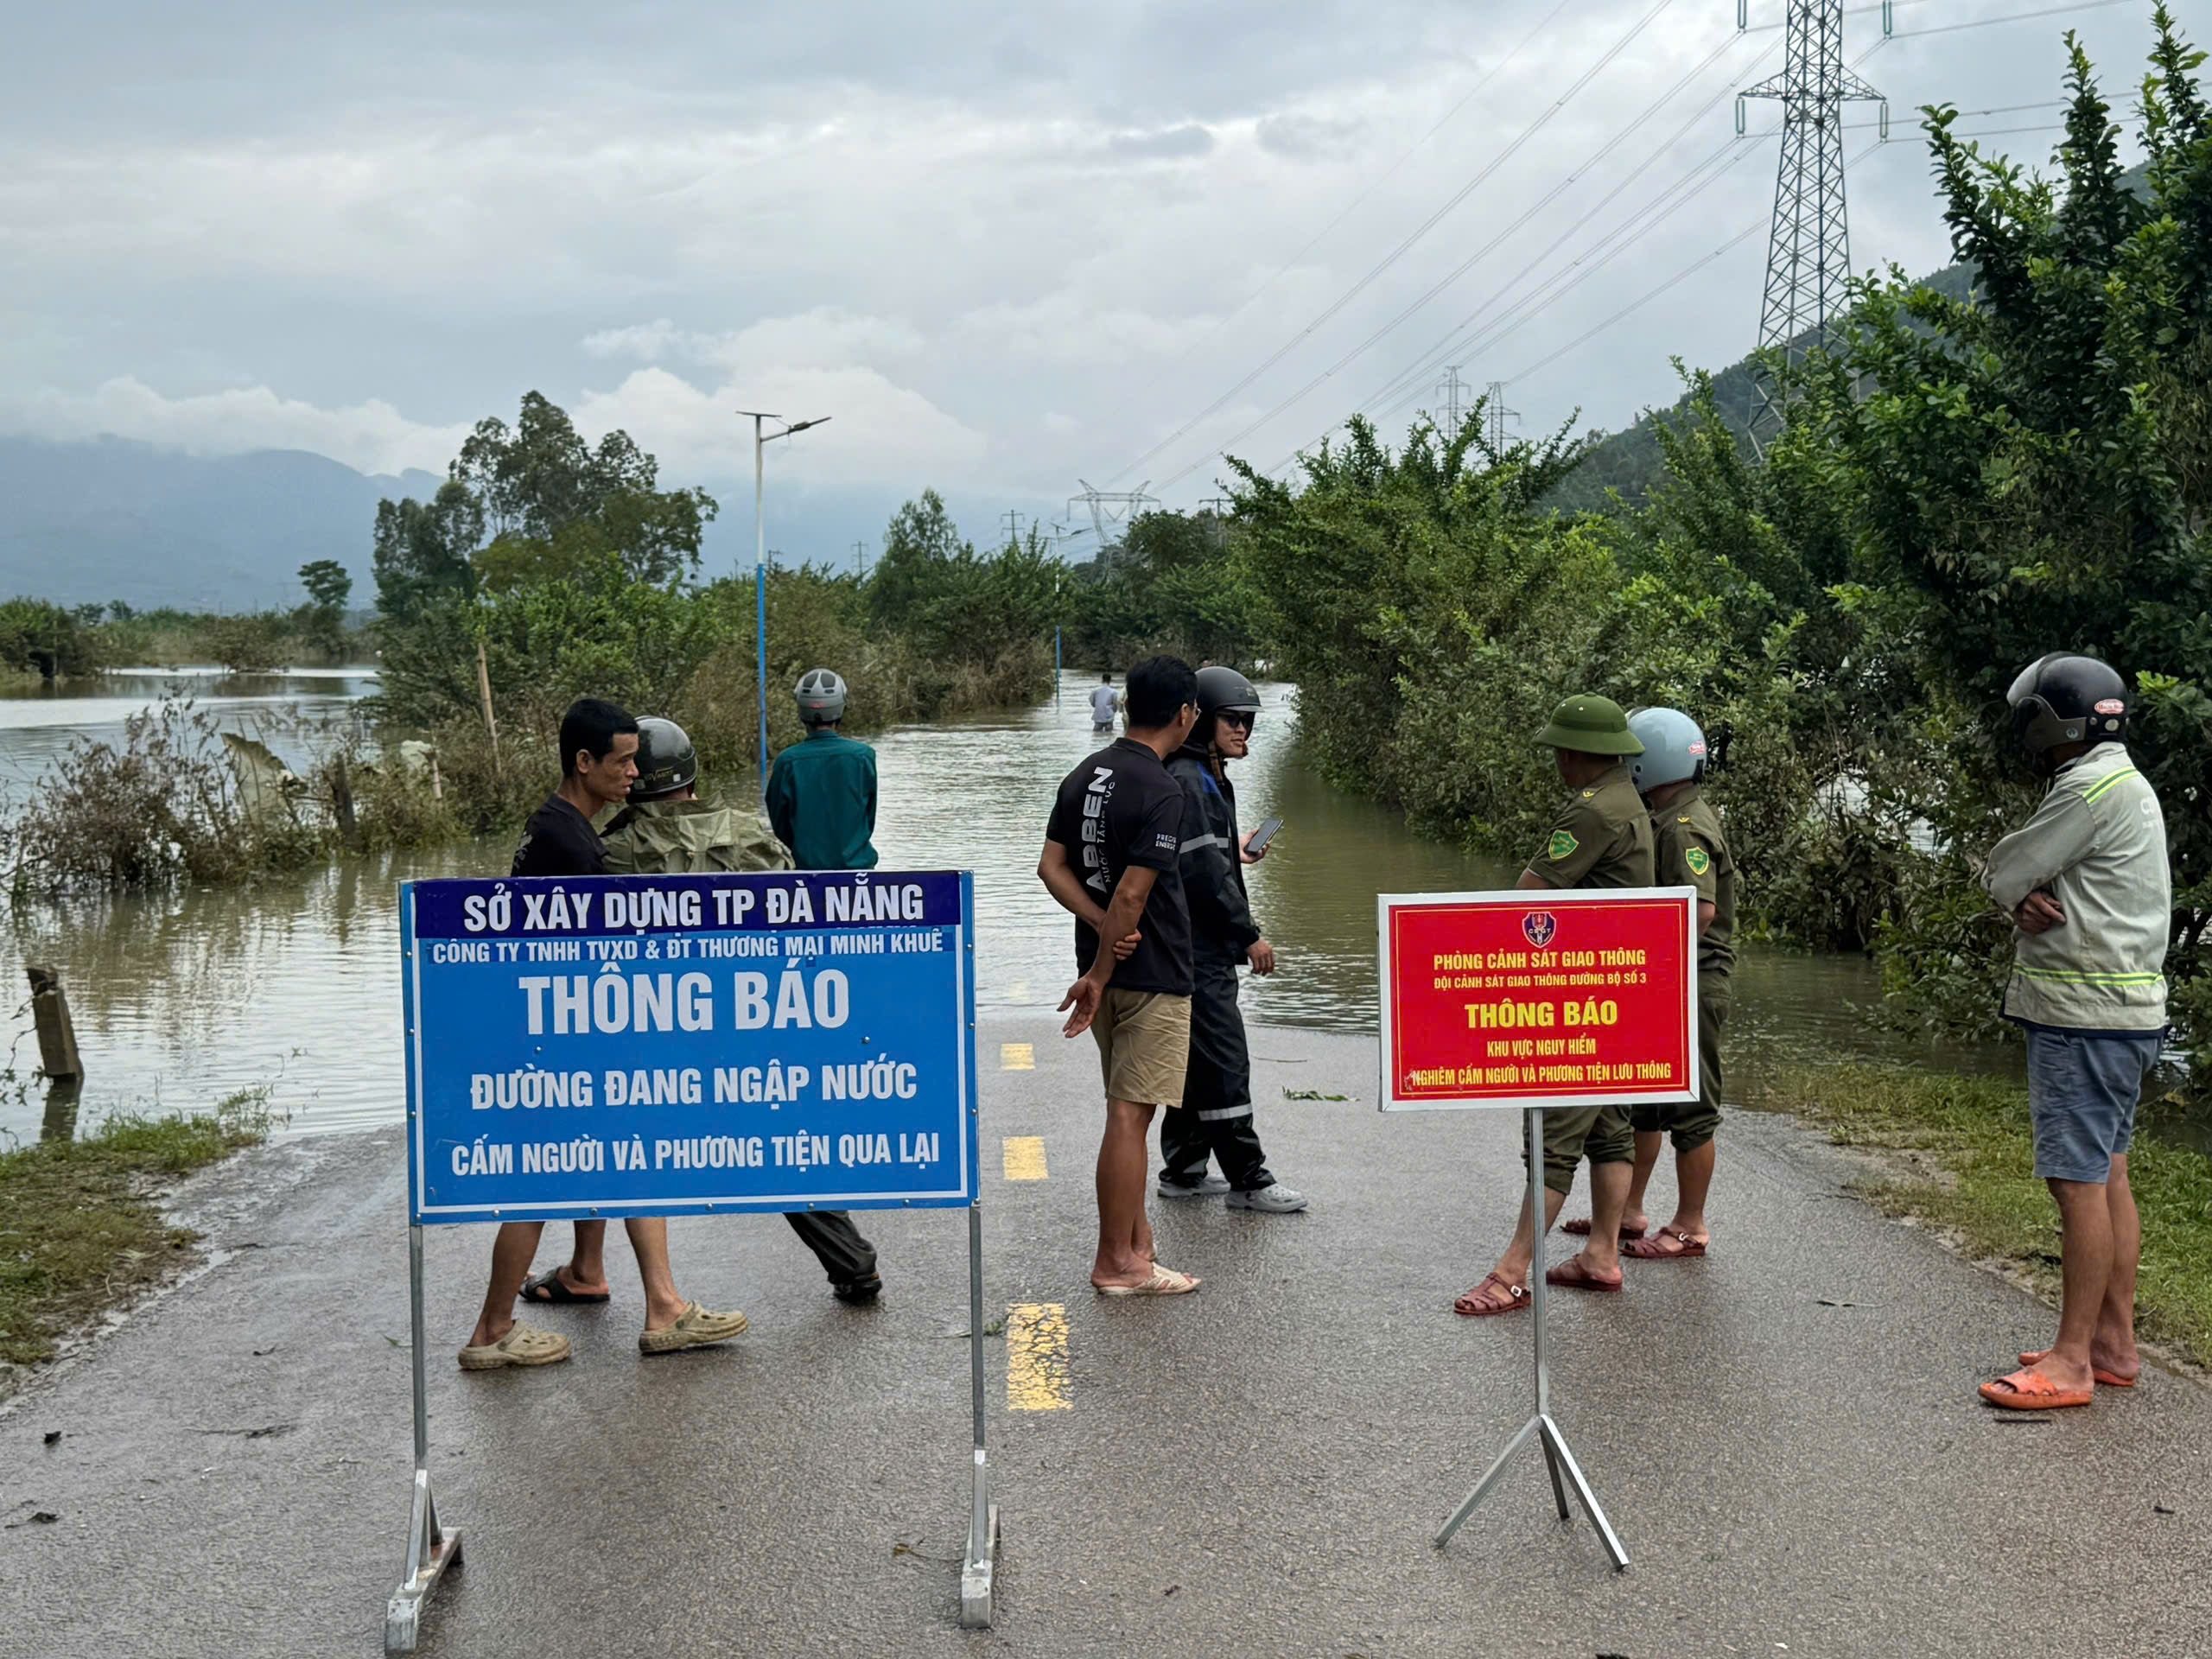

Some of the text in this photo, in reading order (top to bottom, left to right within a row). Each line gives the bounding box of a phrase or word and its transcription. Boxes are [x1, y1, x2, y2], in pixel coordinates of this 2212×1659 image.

[1081, 766, 1114, 894] ABBEN
[465, 872, 924, 935] SỞ XÂY DỰNG TP ĐÀ NẴNG
[433, 928, 944, 963] CÔNG TY TNHH TVXD & ĐT THƯƠNG MẠI MINH KHUÊ
[1433, 947, 1645, 970] PHÒNG CẢNH SÁT GIAO THÔNG
[519, 957, 849, 1035] THÔNG BÁO
[1433, 969, 1646, 991] ĐỘI CẢNH SÁT GIAO THÔNG ĐƯỜNG BỘ SỐ 3
[1465, 996, 1618, 1028] THÔNG BÁO
[1486, 1041, 1510, 1058] KHU
[1511, 1039, 1534, 1059] VỰC
[1536, 1039, 1565, 1055] NGUY
[471, 1053, 916, 1109] ĐƯỜNG ĐANG NGẬP NƯỚC
[1412, 1059, 1671, 1086] NGHIÊM CẤM NGƯỜI VÀ PHƯƠNG TIỆN LƯU THÔNG
[453, 1130, 938, 1175] CẤM NGƯỜI VÀ PHƯƠNG TIỆN QUA LẠI
